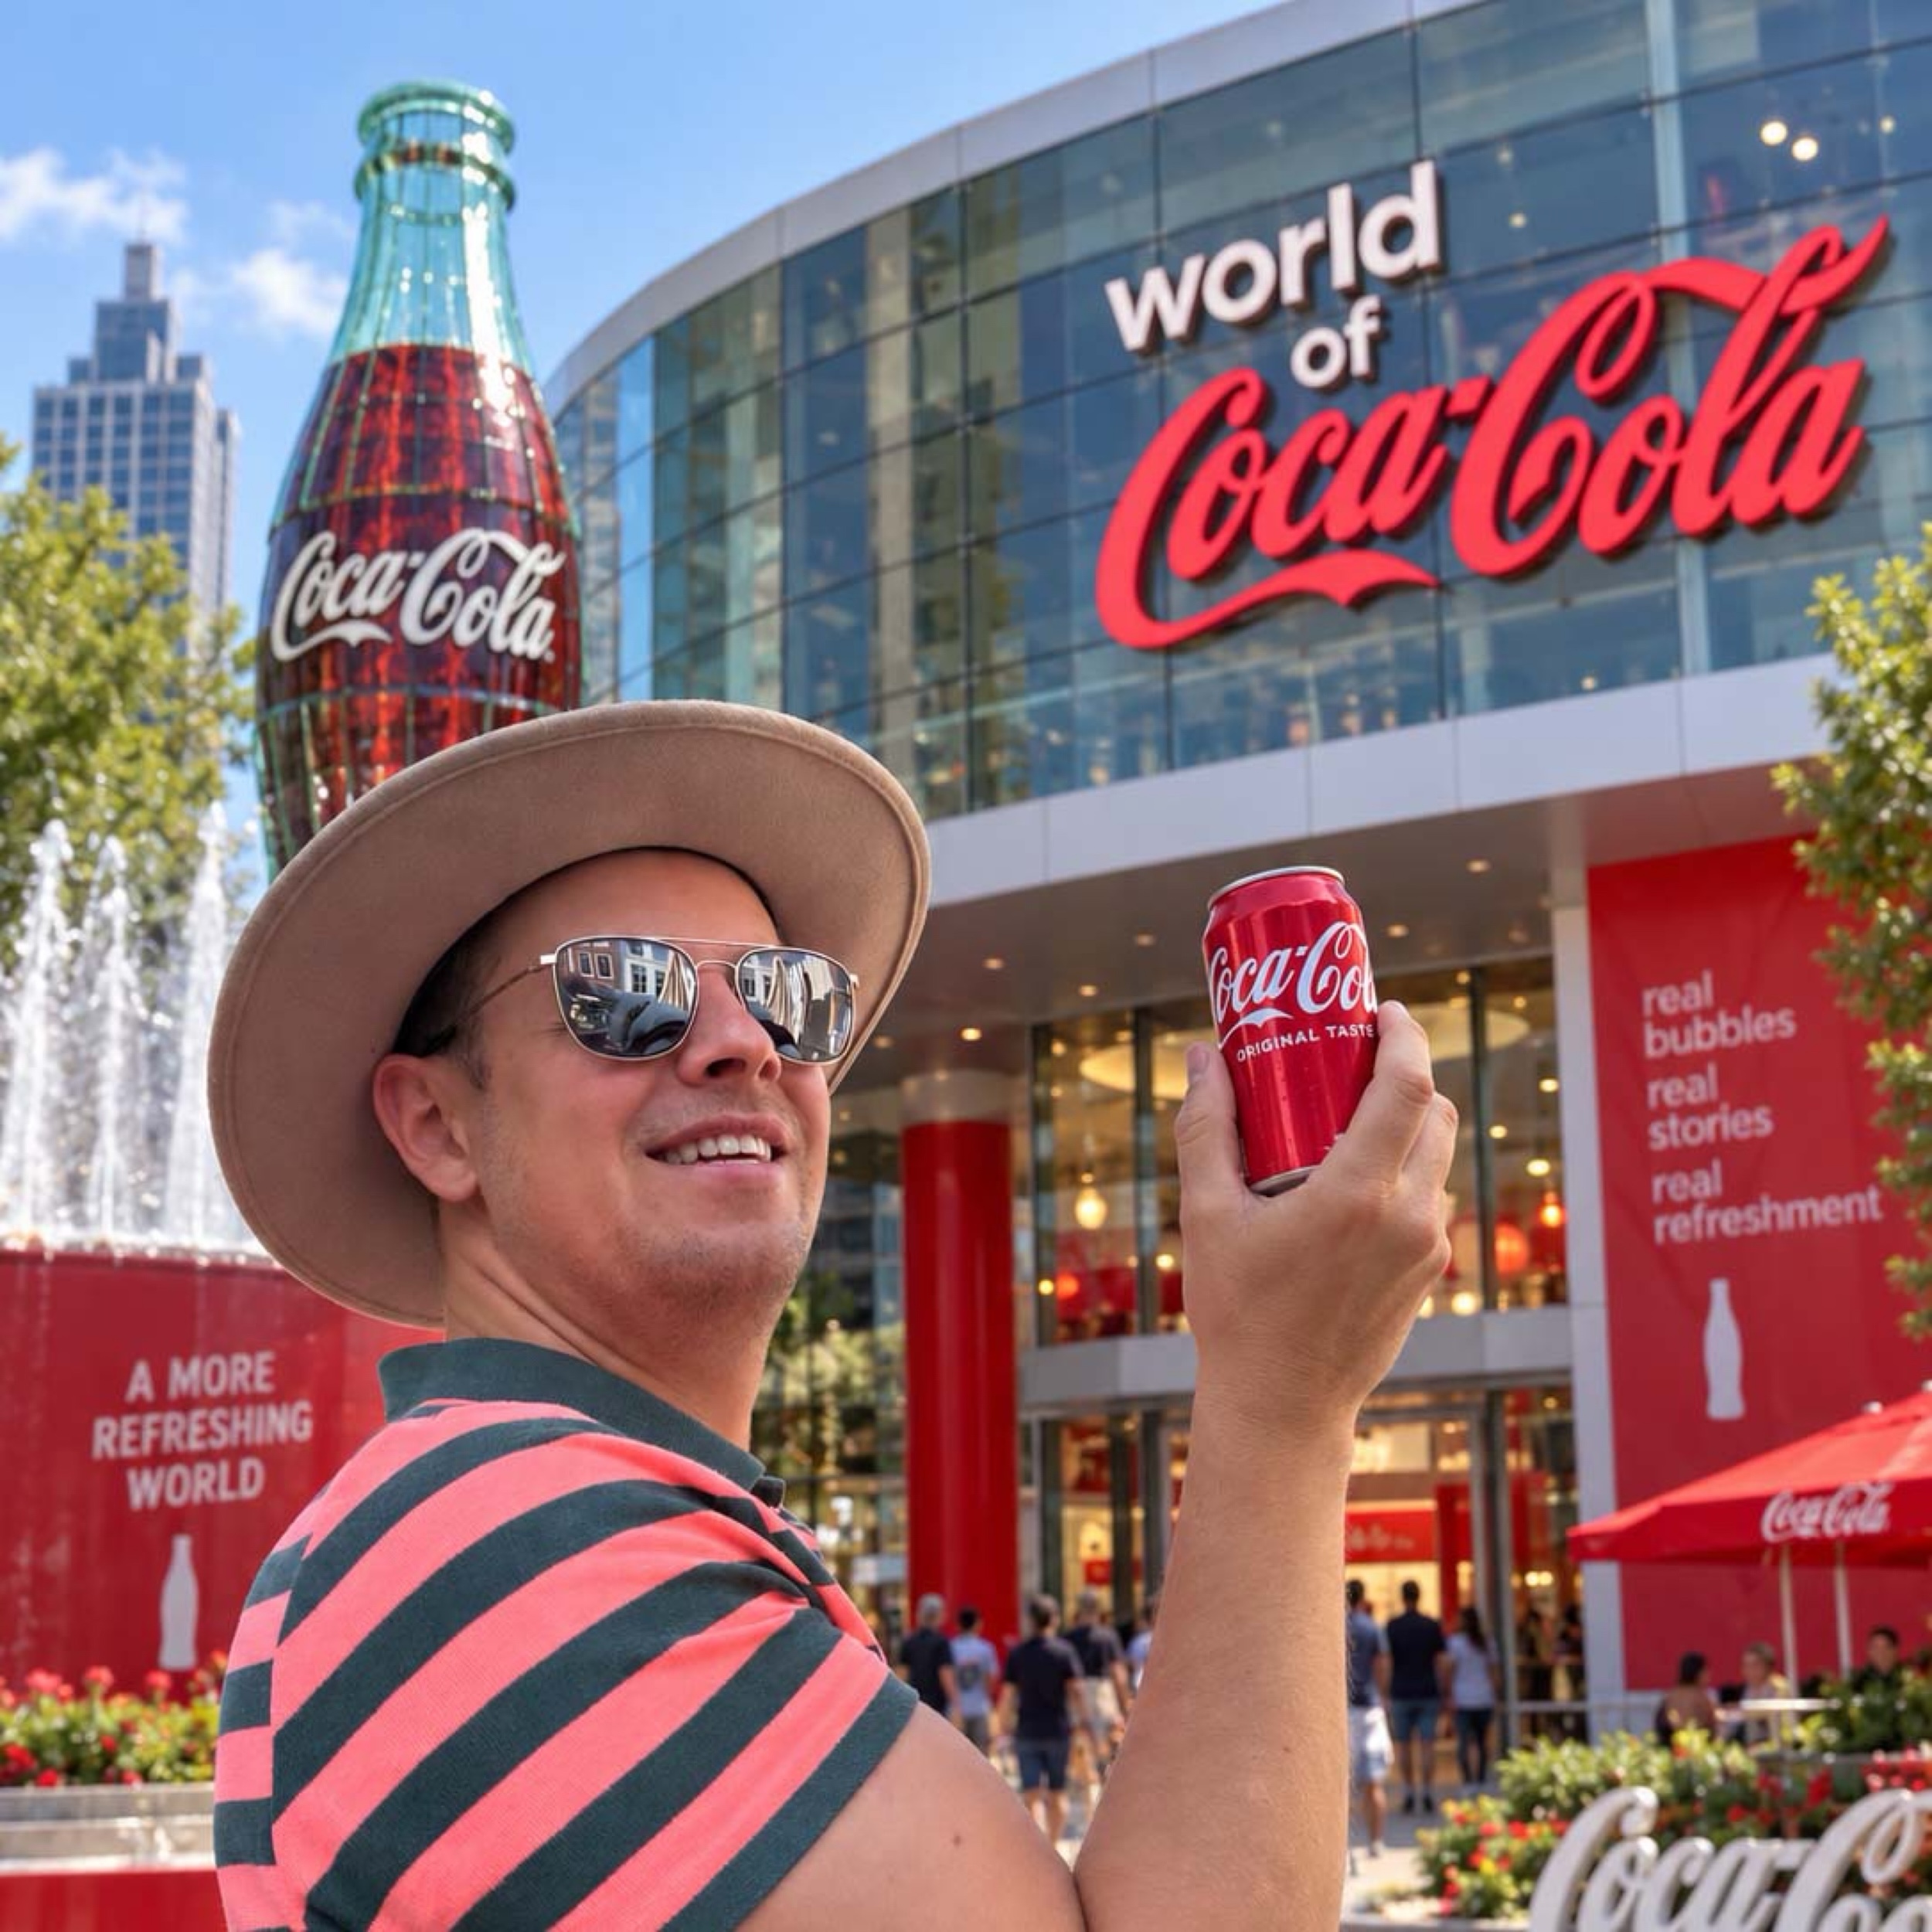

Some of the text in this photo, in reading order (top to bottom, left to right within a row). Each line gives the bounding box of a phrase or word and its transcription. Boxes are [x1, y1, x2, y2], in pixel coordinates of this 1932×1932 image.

[1105, 159, 1440, 352] world
[1290, 295, 1380, 388] of
[1095, 216, 1888, 650] Coca-Cola
[270, 527, 566, 662] Coca-Cola
[1641, 969, 1714, 1017] real
[1237, 1023, 1374, 1063] ORIGINAL TASTE
[1644, 1005, 1798, 1059] bubbles
[1647, 1062, 1719, 1109] real
[1648, 1105, 1774, 1151] stories
[1651, 1158, 1723, 1204] real
[1653, 1185, 1883, 1244] refreshment
[124, 1350, 276, 1403] A MORE
[90, 1400, 314, 1460] REFRESHING
[125, 1457, 266, 1511] WORLD
